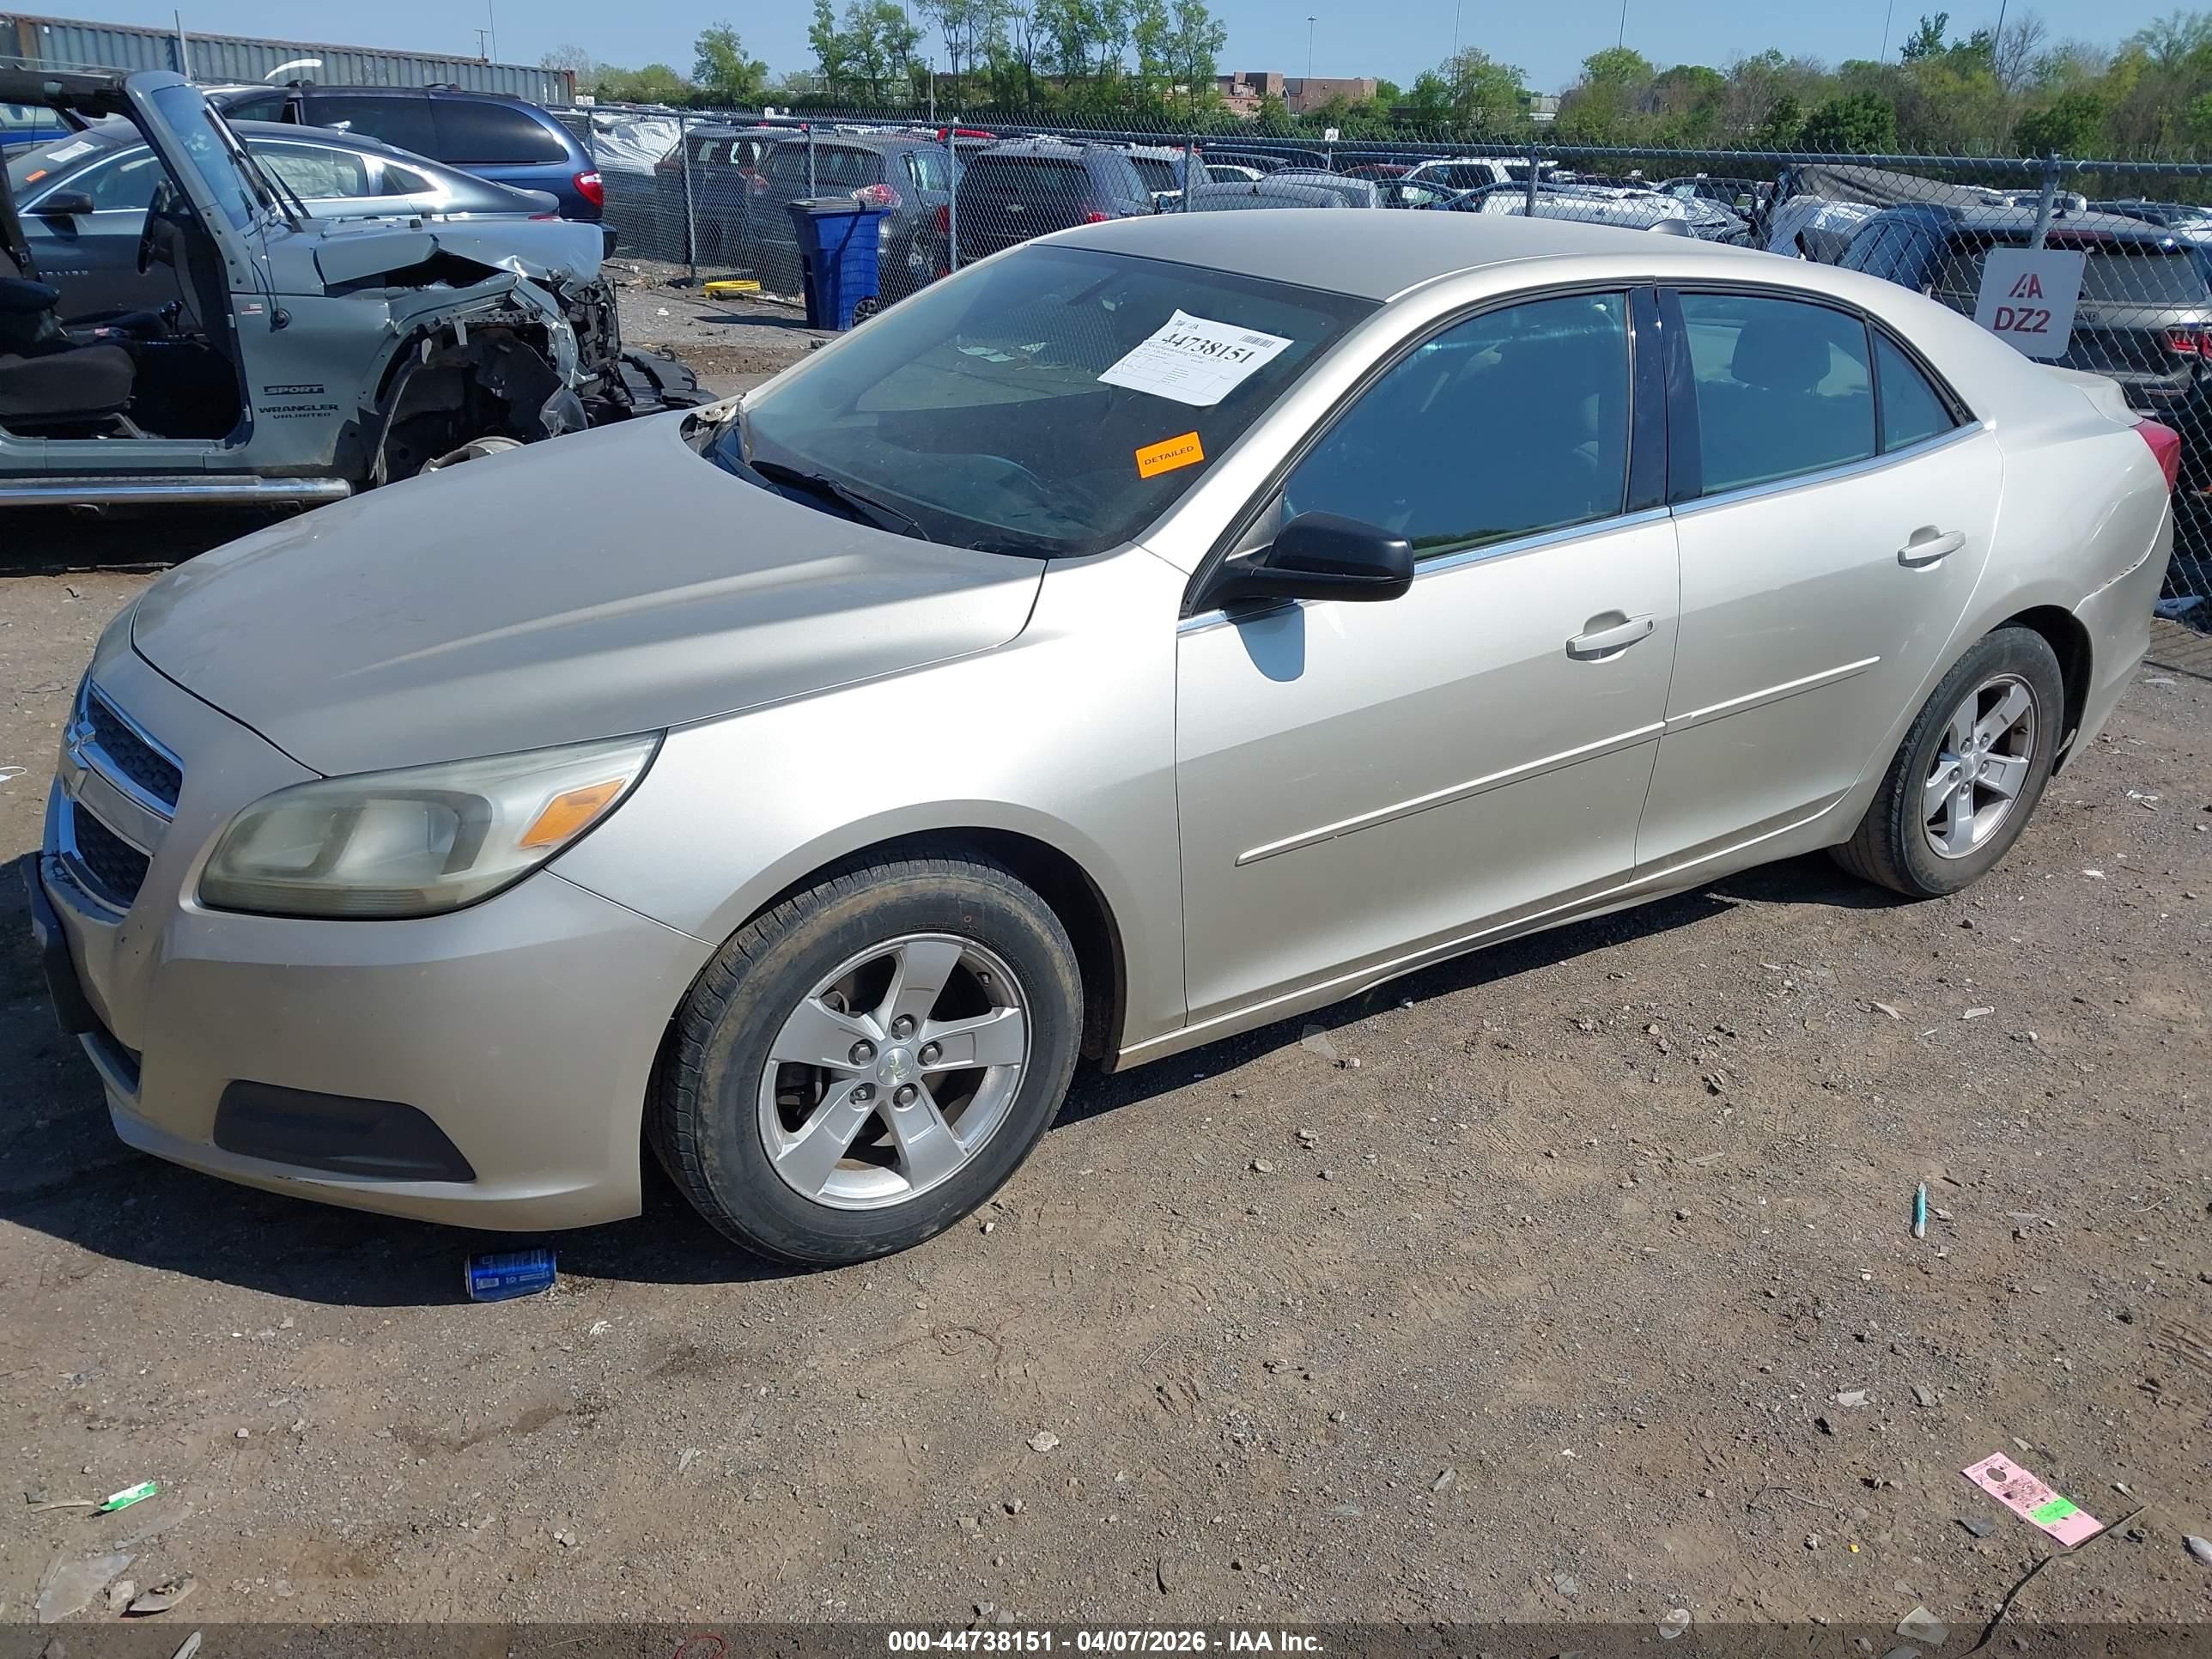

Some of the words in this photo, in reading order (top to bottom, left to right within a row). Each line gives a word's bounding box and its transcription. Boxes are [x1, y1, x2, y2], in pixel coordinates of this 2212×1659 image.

[1993, 307, 2051, 333] DZ2
[1161, 333, 1256, 364] 44738151
[264, 386, 321, 394] SPORT
[258, 404, 340, 413] WRANGLER
[1144, 446, 1194, 465] DETAILED
